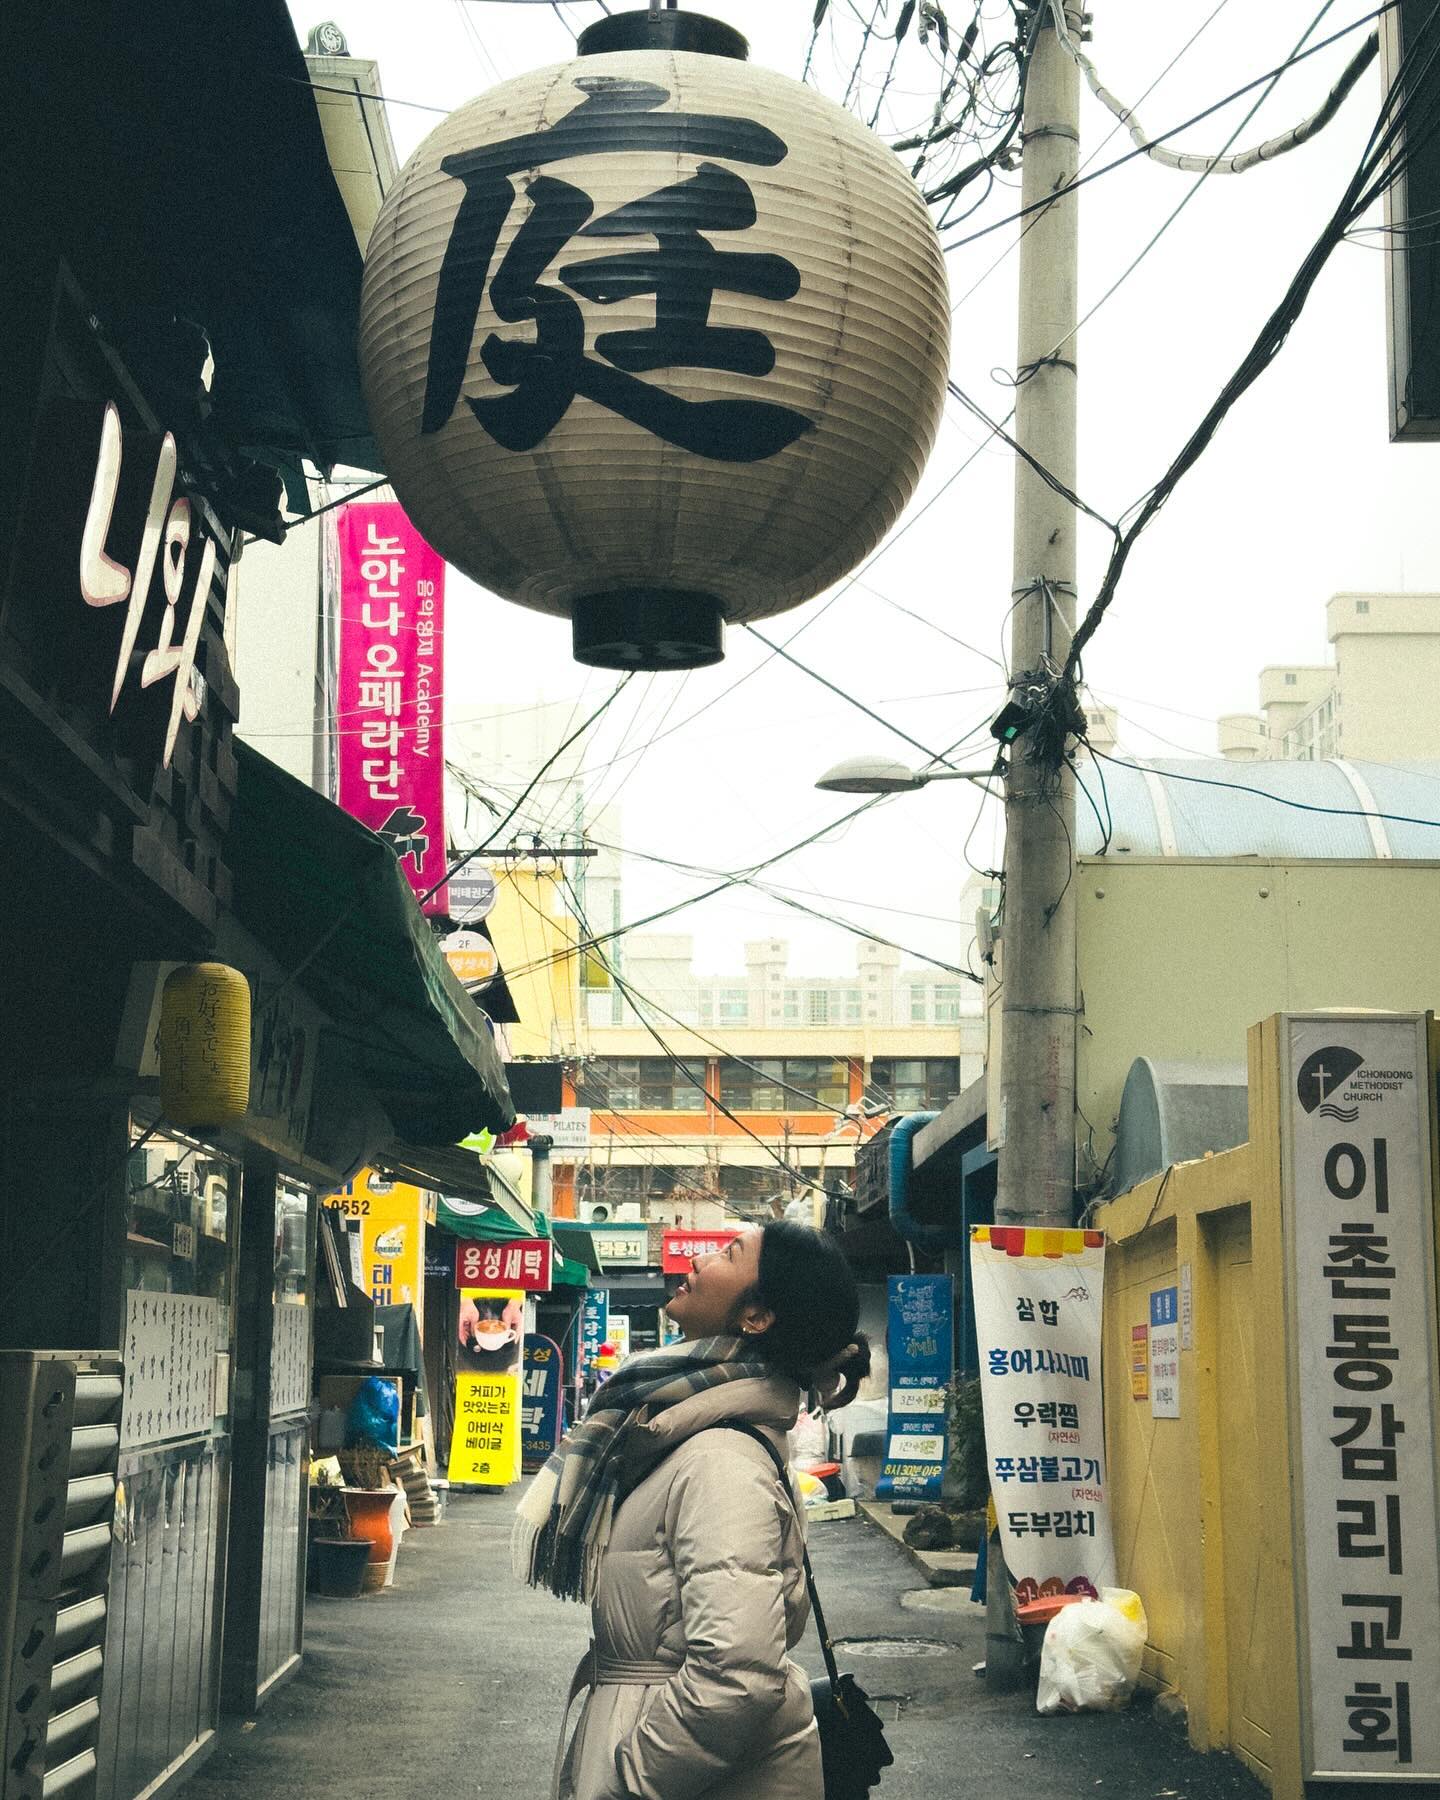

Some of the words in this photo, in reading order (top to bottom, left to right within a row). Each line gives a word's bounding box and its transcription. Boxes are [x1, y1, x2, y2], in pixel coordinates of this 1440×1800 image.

[422, 76, 815, 463] 庭
[360, 524, 406, 637] 노안나
[416, 579, 434, 656] 음악영재
[358, 643, 406, 801] 오페라단
[412, 663, 434, 758] Academy
[457, 939, 471, 949] 2F
[1350, 1081, 1403, 1091] METHODIST
[1357, 1070, 1414, 1080] ICHONDONG
[1343, 1092, 1383, 1102] CHURCH
[553, 1120, 587, 1132] PILATES
[463, 1247, 543, 1280] 용성세탁
[1016, 1297, 1060, 1326] 삼합
[988, 1348, 1090, 1381] 홍어사시미
[470, 1385, 506, 1398] 커피가
[467, 1421, 504, 1434] 아비삭
[1014, 1401, 1080, 1429] 우럭찜
[465, 1437, 502, 1451] 베이글
[1048, 1431, 1081, 1444] (자연산)
[1322, 1138, 1413, 1764] 이촌동감리교회
[472, 1462, 491, 1474] 2층
[994, 1456, 1102, 1485] 쭈삼불고기
[1007, 1510, 1095, 1538] 두부김치
